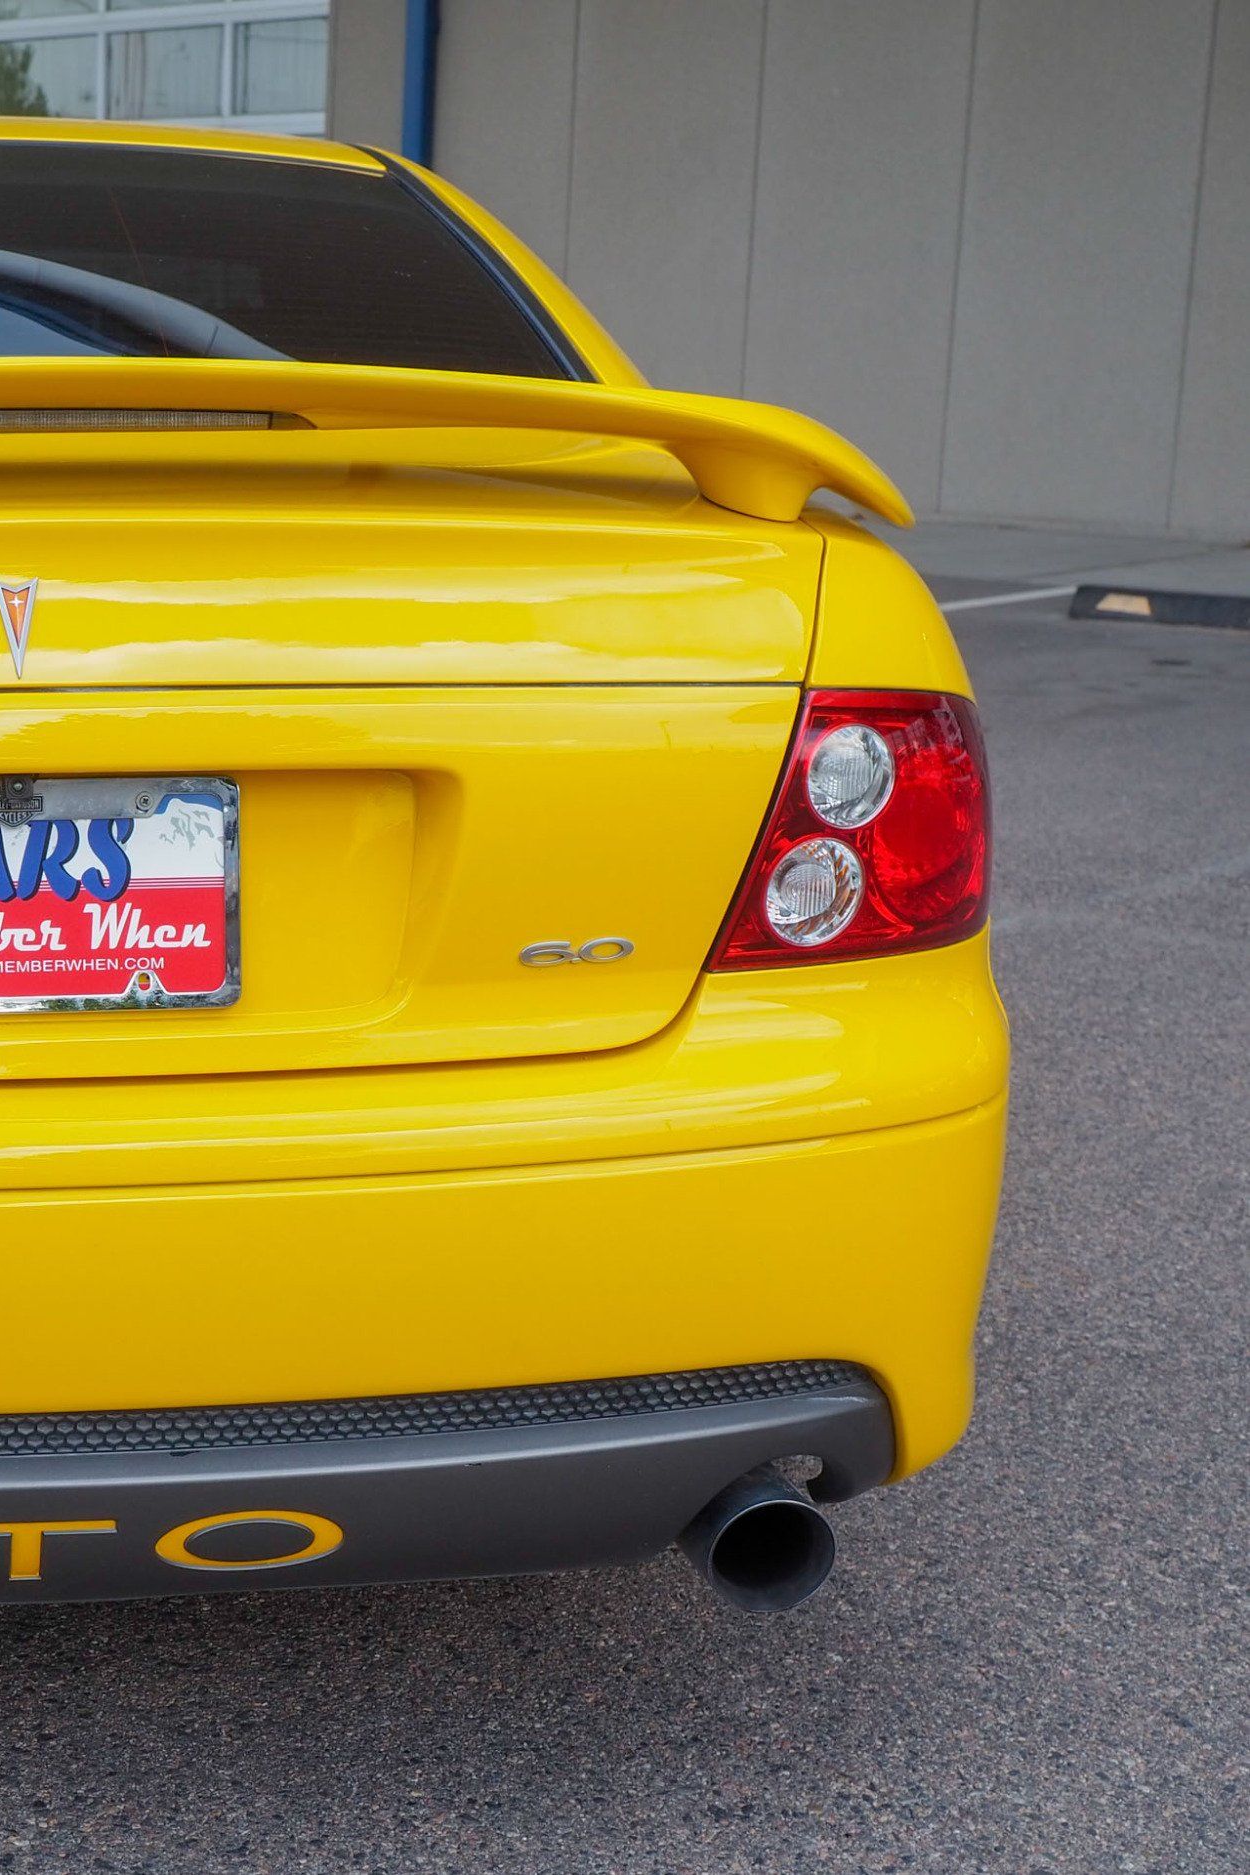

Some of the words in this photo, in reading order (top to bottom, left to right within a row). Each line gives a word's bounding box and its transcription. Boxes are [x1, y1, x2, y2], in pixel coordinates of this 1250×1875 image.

[0, 811, 27, 824] CYCLES
[83, 902, 211, 950] When
[519, 937, 634, 968] 6.0
